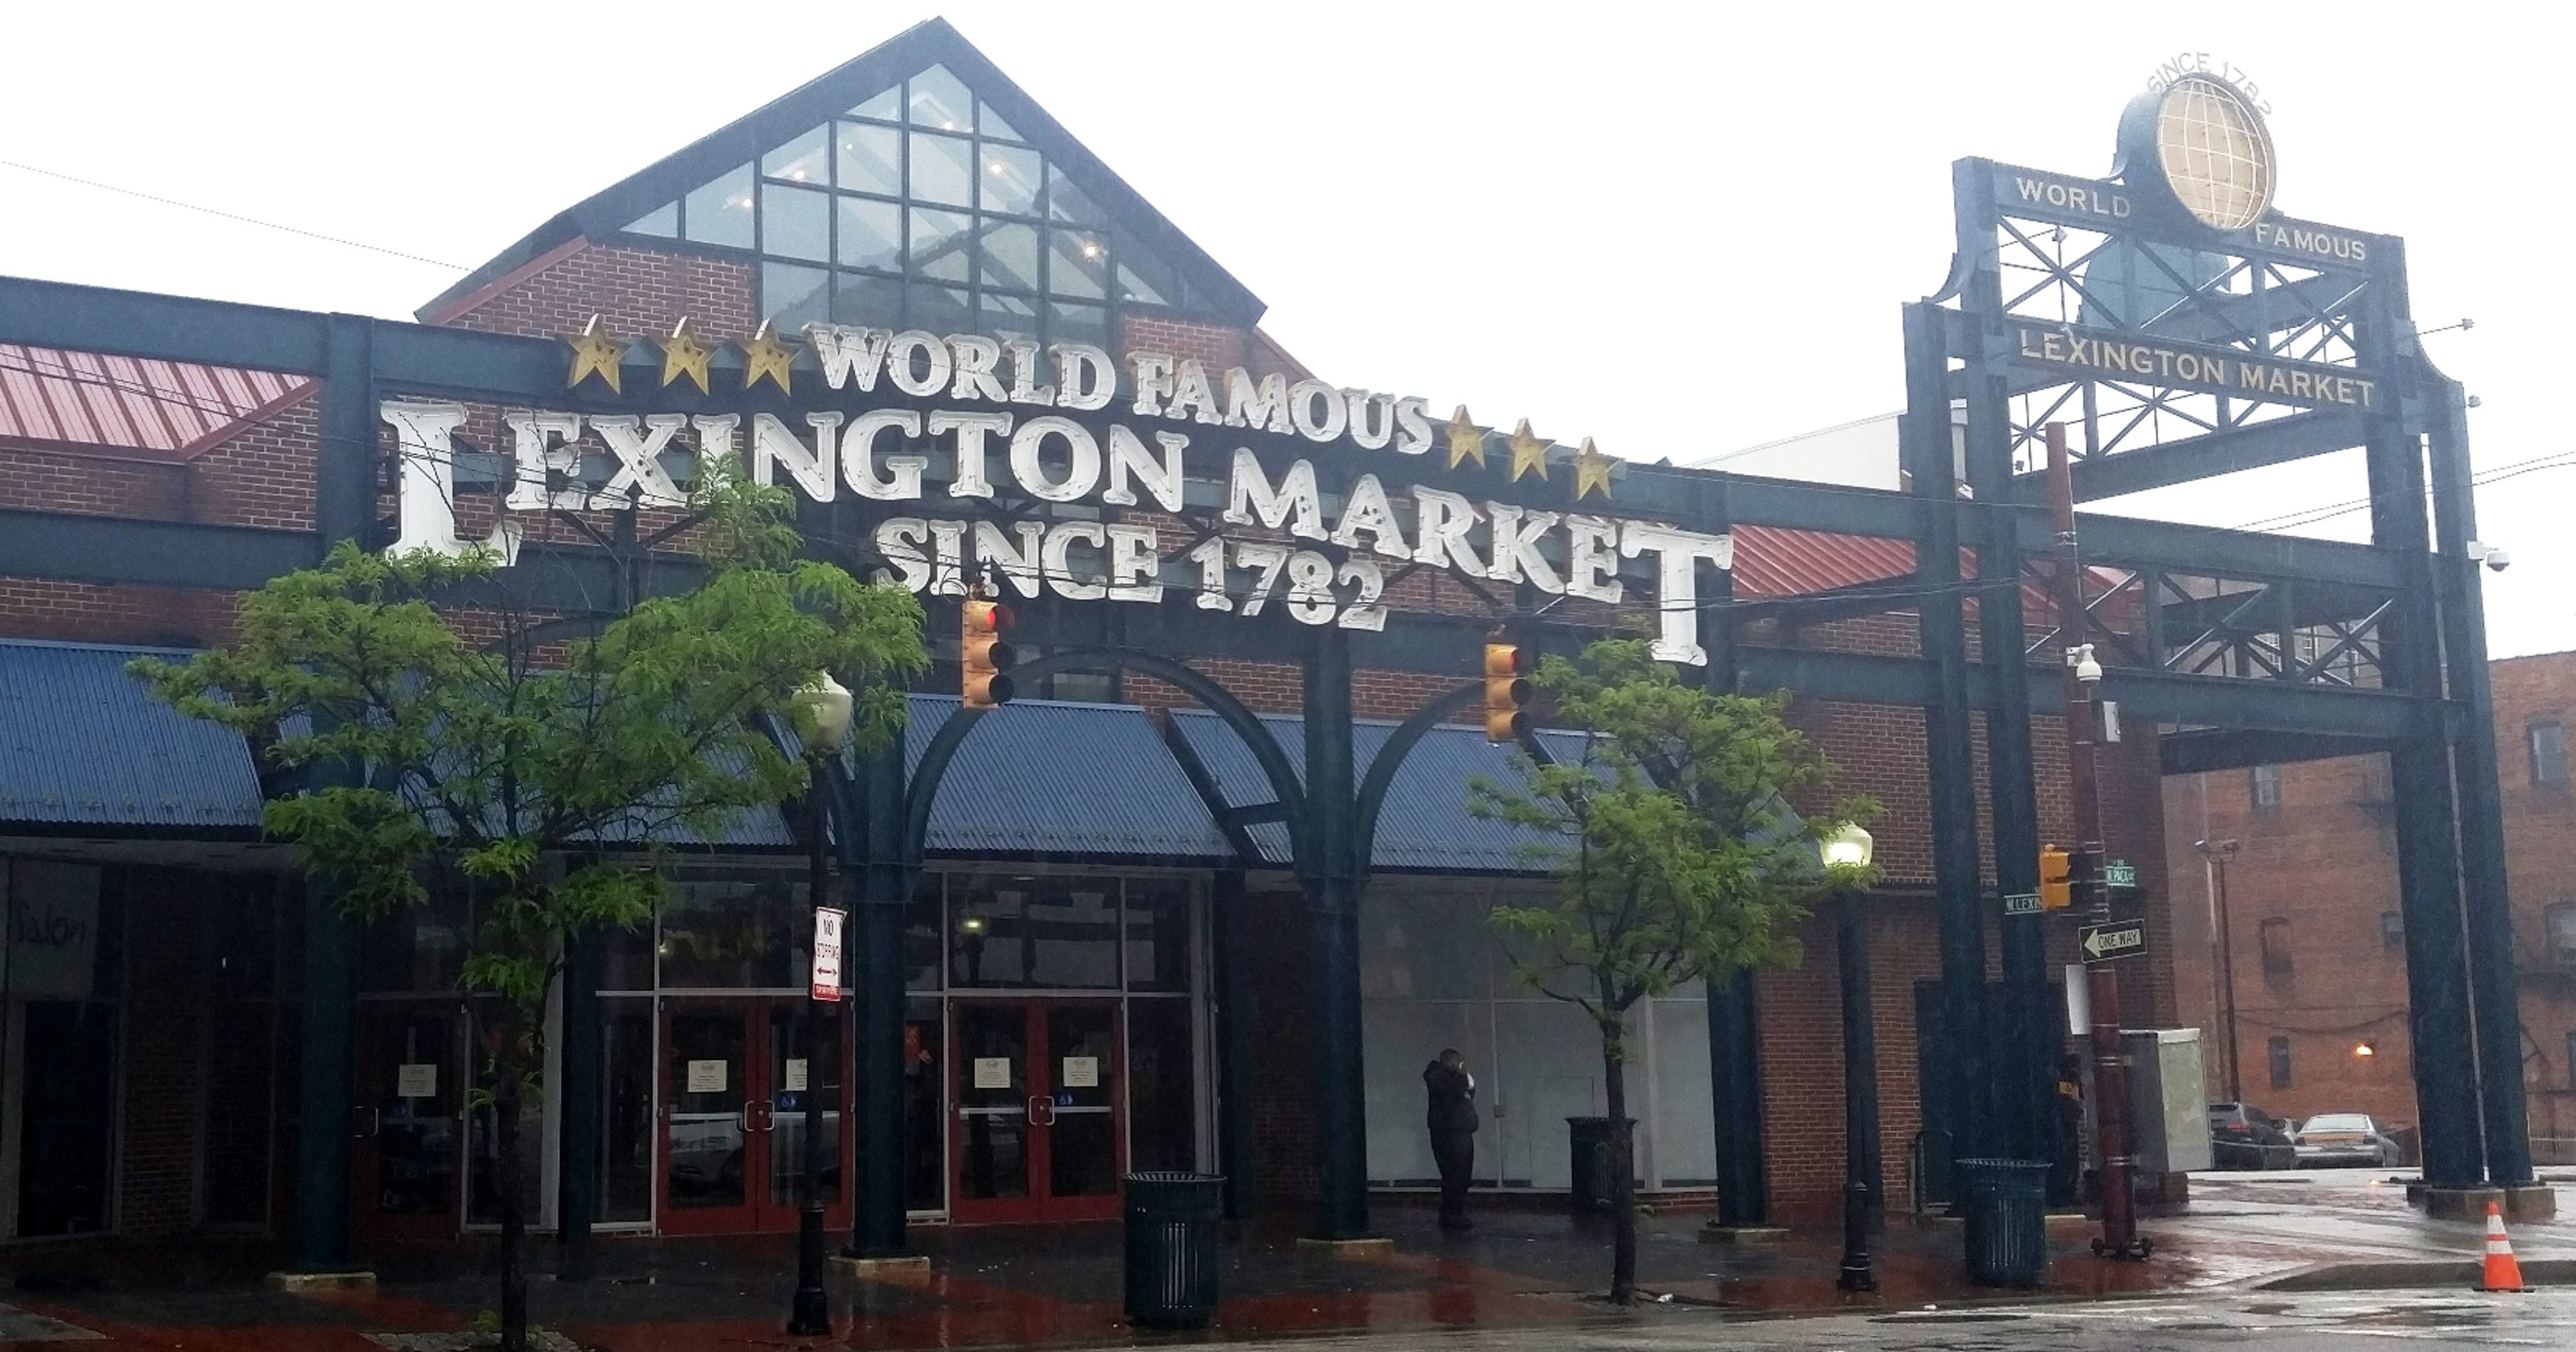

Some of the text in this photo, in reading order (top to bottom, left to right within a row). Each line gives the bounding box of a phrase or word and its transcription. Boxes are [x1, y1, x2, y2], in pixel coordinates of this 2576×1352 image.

[2147, 52, 2272, 122] SINCE 1782
[2016, 176, 2367, 262] WORLD FAMOUS
[803, 322, 1434, 455] WORLD FAMOUS
[2021, 328, 2376, 407] LEXINGTON MARKET
[380, 399, 1733, 667] LEXINGTON MARKET
[872, 516, 1388, 633] SINCE 1782
[823, 919, 834, 936] NO
[2099, 931, 2138, 949] ONE WAY
